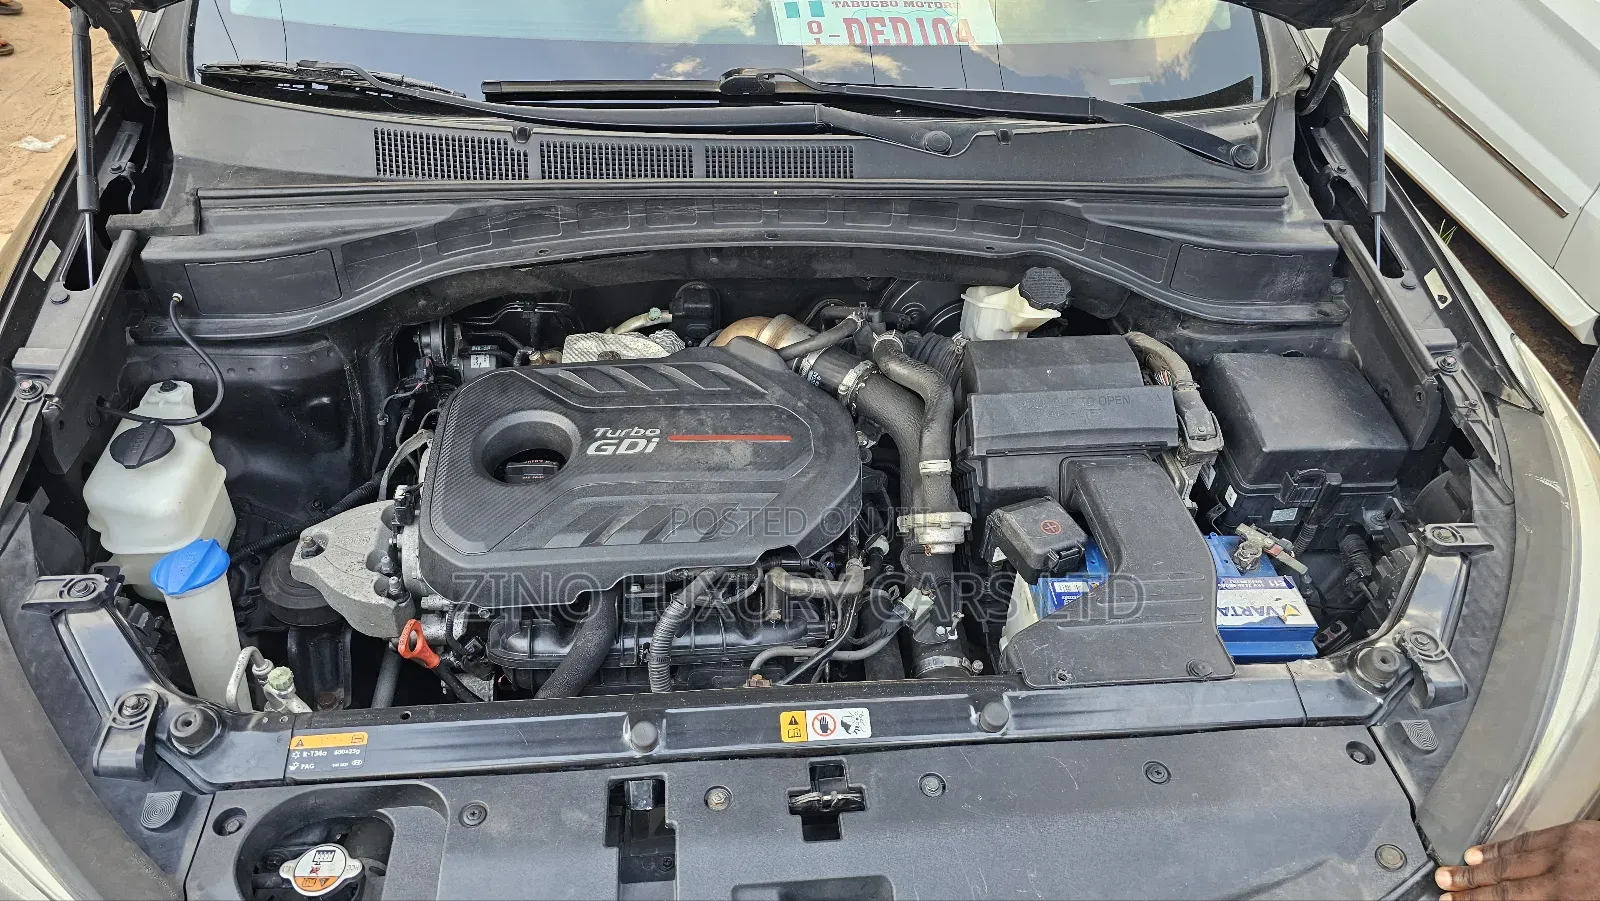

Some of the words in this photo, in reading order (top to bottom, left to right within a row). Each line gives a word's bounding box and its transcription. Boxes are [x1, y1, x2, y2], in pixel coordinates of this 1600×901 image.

[1099, 395, 1130, 406] OPEN
[593, 426, 661, 438] Turbo
[586, 438, 660, 455] GDi
[1216, 606, 1280, 617] VARTA
